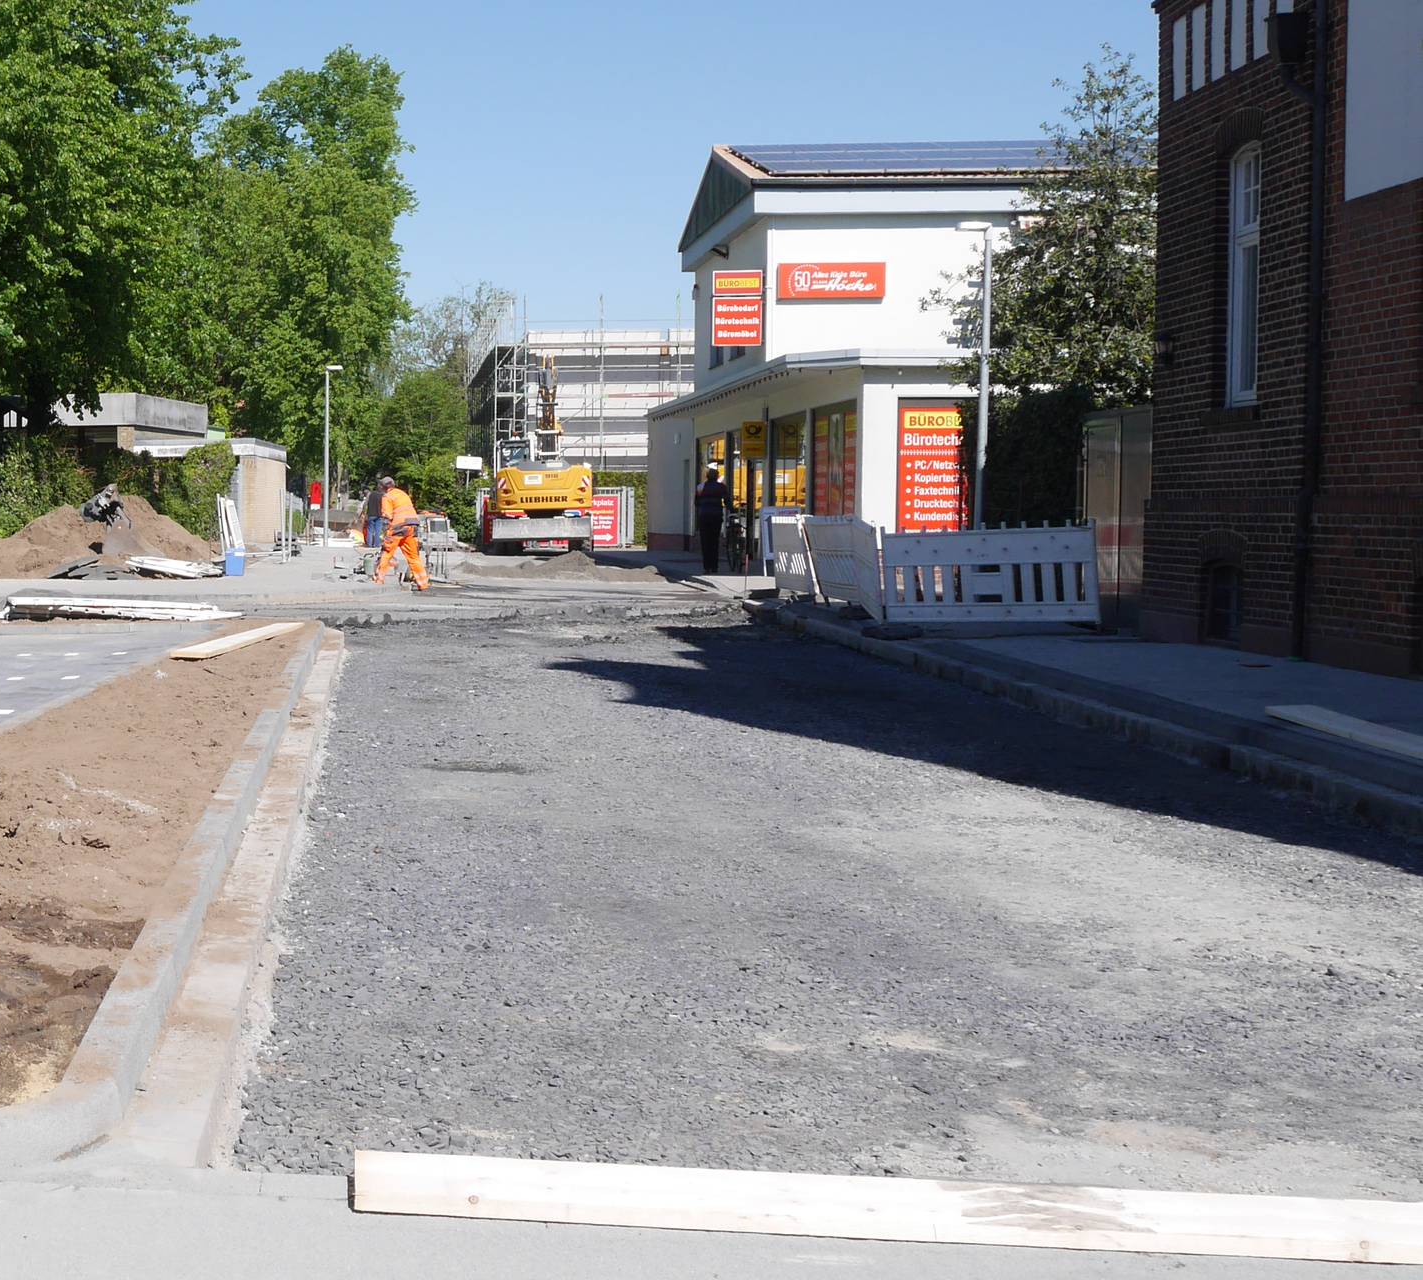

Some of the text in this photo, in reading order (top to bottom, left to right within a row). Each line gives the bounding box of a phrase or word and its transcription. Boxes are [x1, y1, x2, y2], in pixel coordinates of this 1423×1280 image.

[794, 271, 810, 287] 50
[717, 304, 758, 313] Bürobedarf
[715, 317, 760, 325] Bürotechnik
[904, 433, 963, 446] Bürotech
[520, 495, 568, 504] LIEBHERR
[913, 498, 960, 509] Drucktech
